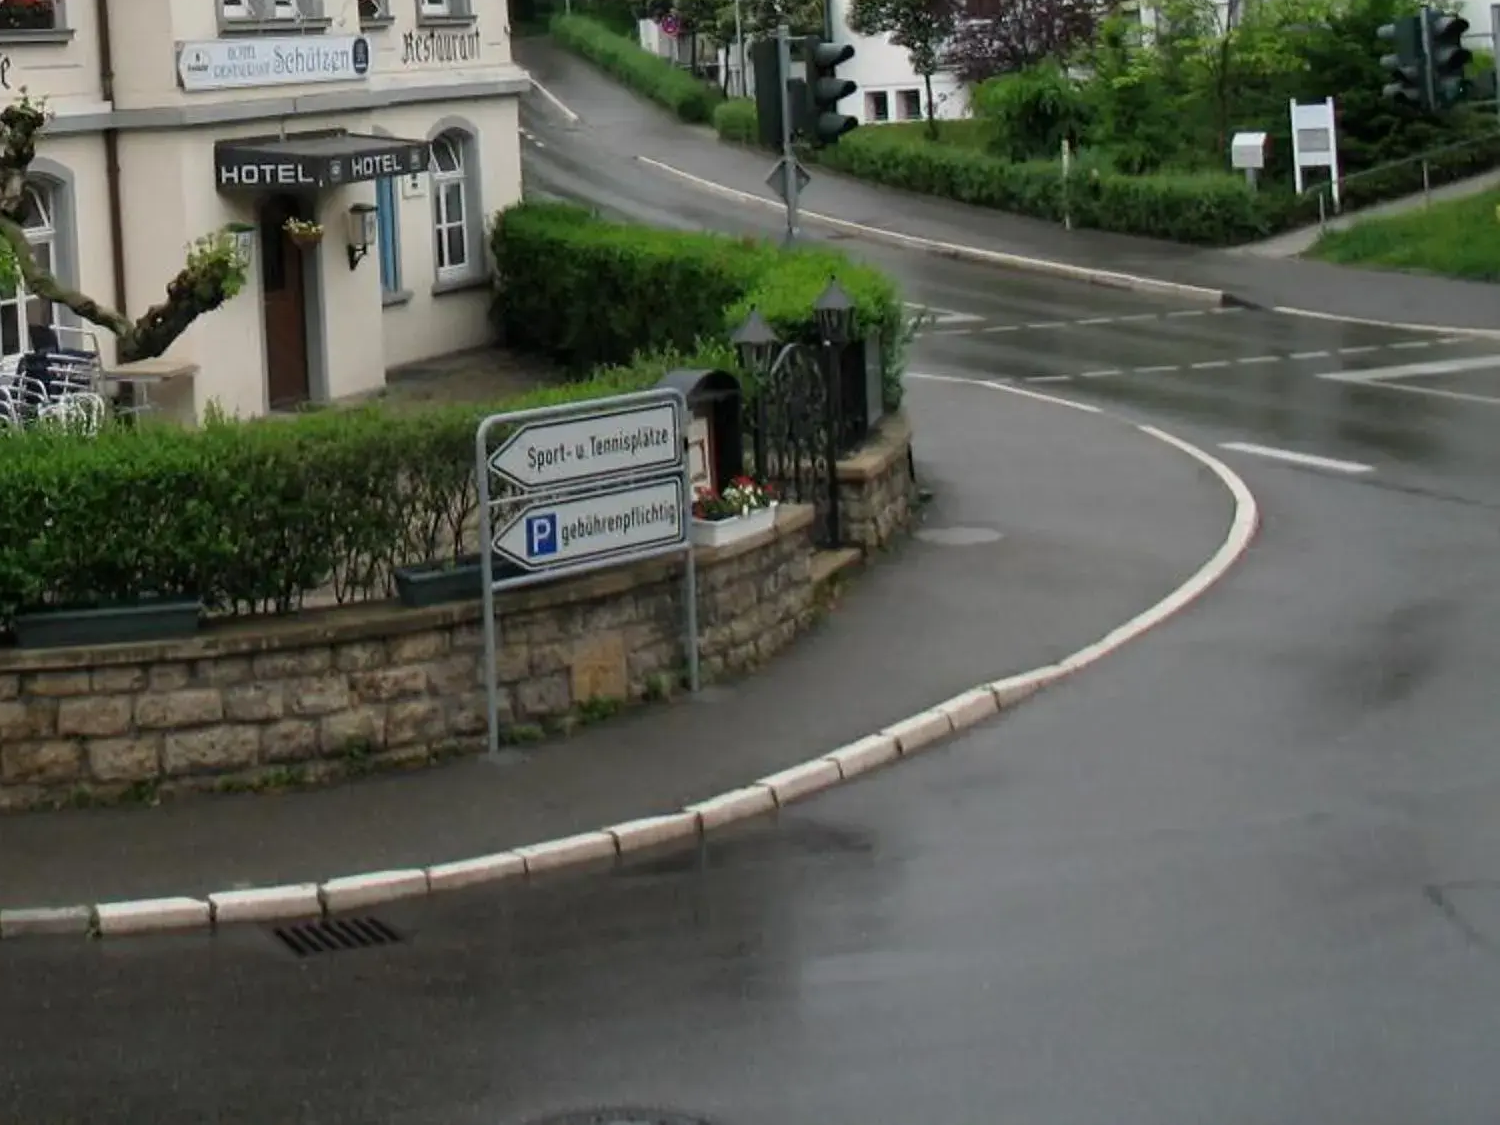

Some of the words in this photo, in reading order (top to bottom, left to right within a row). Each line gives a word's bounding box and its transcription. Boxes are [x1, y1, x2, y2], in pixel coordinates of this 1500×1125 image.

[273, 43, 349, 75] Schützen
[401, 27, 481, 64] Restaurant
[220, 163, 315, 185] HOTEL
[352, 154, 403, 177] HOTEL
[527, 442, 572, 472] Sport-
[533, 518, 551, 553] P
[561, 501, 676, 546] gebührenpflichtig
